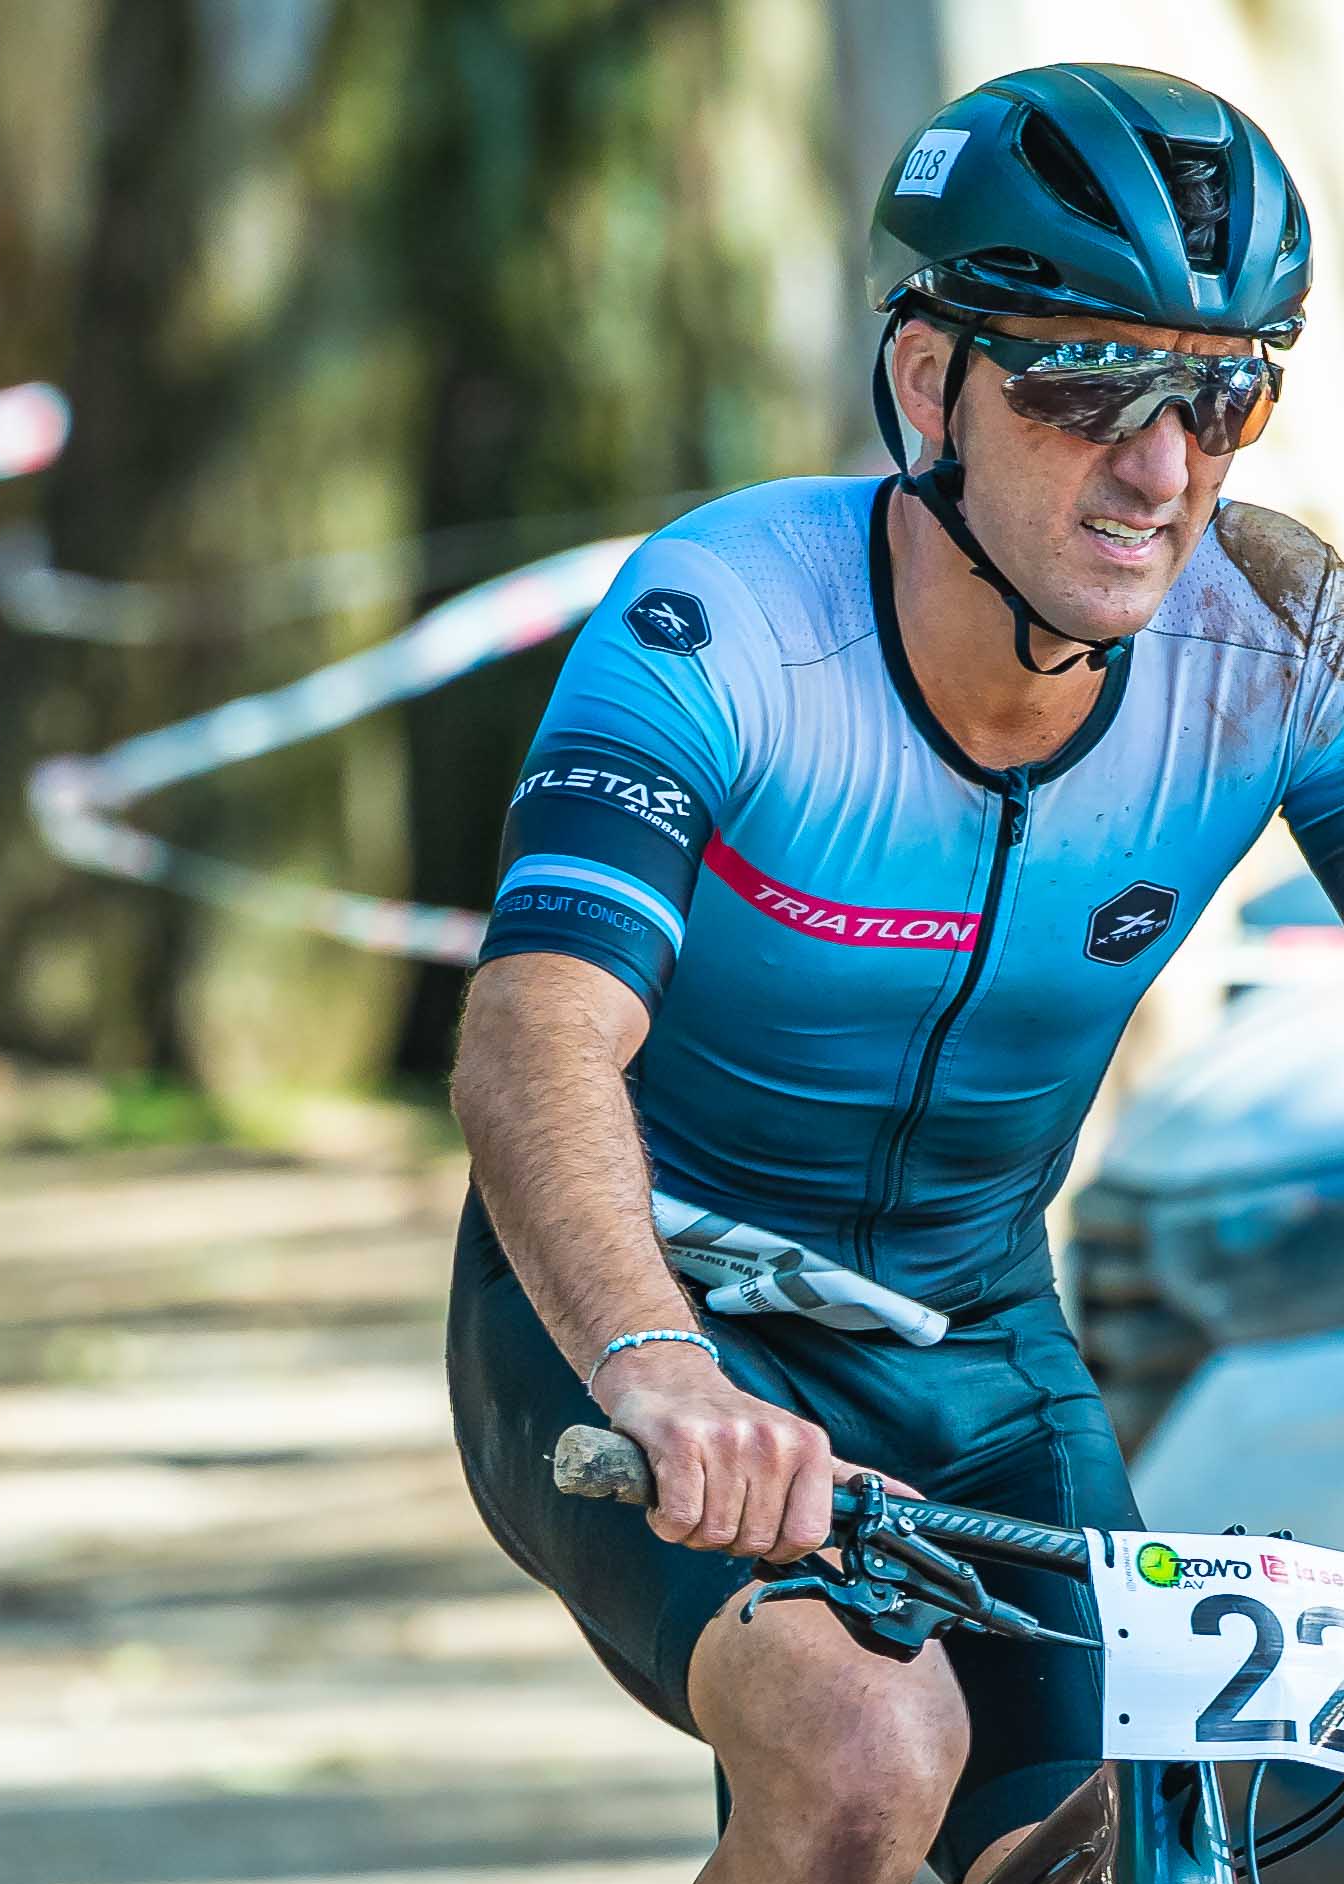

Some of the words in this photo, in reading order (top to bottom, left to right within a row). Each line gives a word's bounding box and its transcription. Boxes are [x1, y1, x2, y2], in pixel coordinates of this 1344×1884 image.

[904, 148, 947, 181] 018
[535, 894, 575, 913] SUIT
[576, 900, 649, 943] CONCEPT
[753, 883, 977, 943] TRIATLON
[1169, 1579, 1205, 1590] RAV
